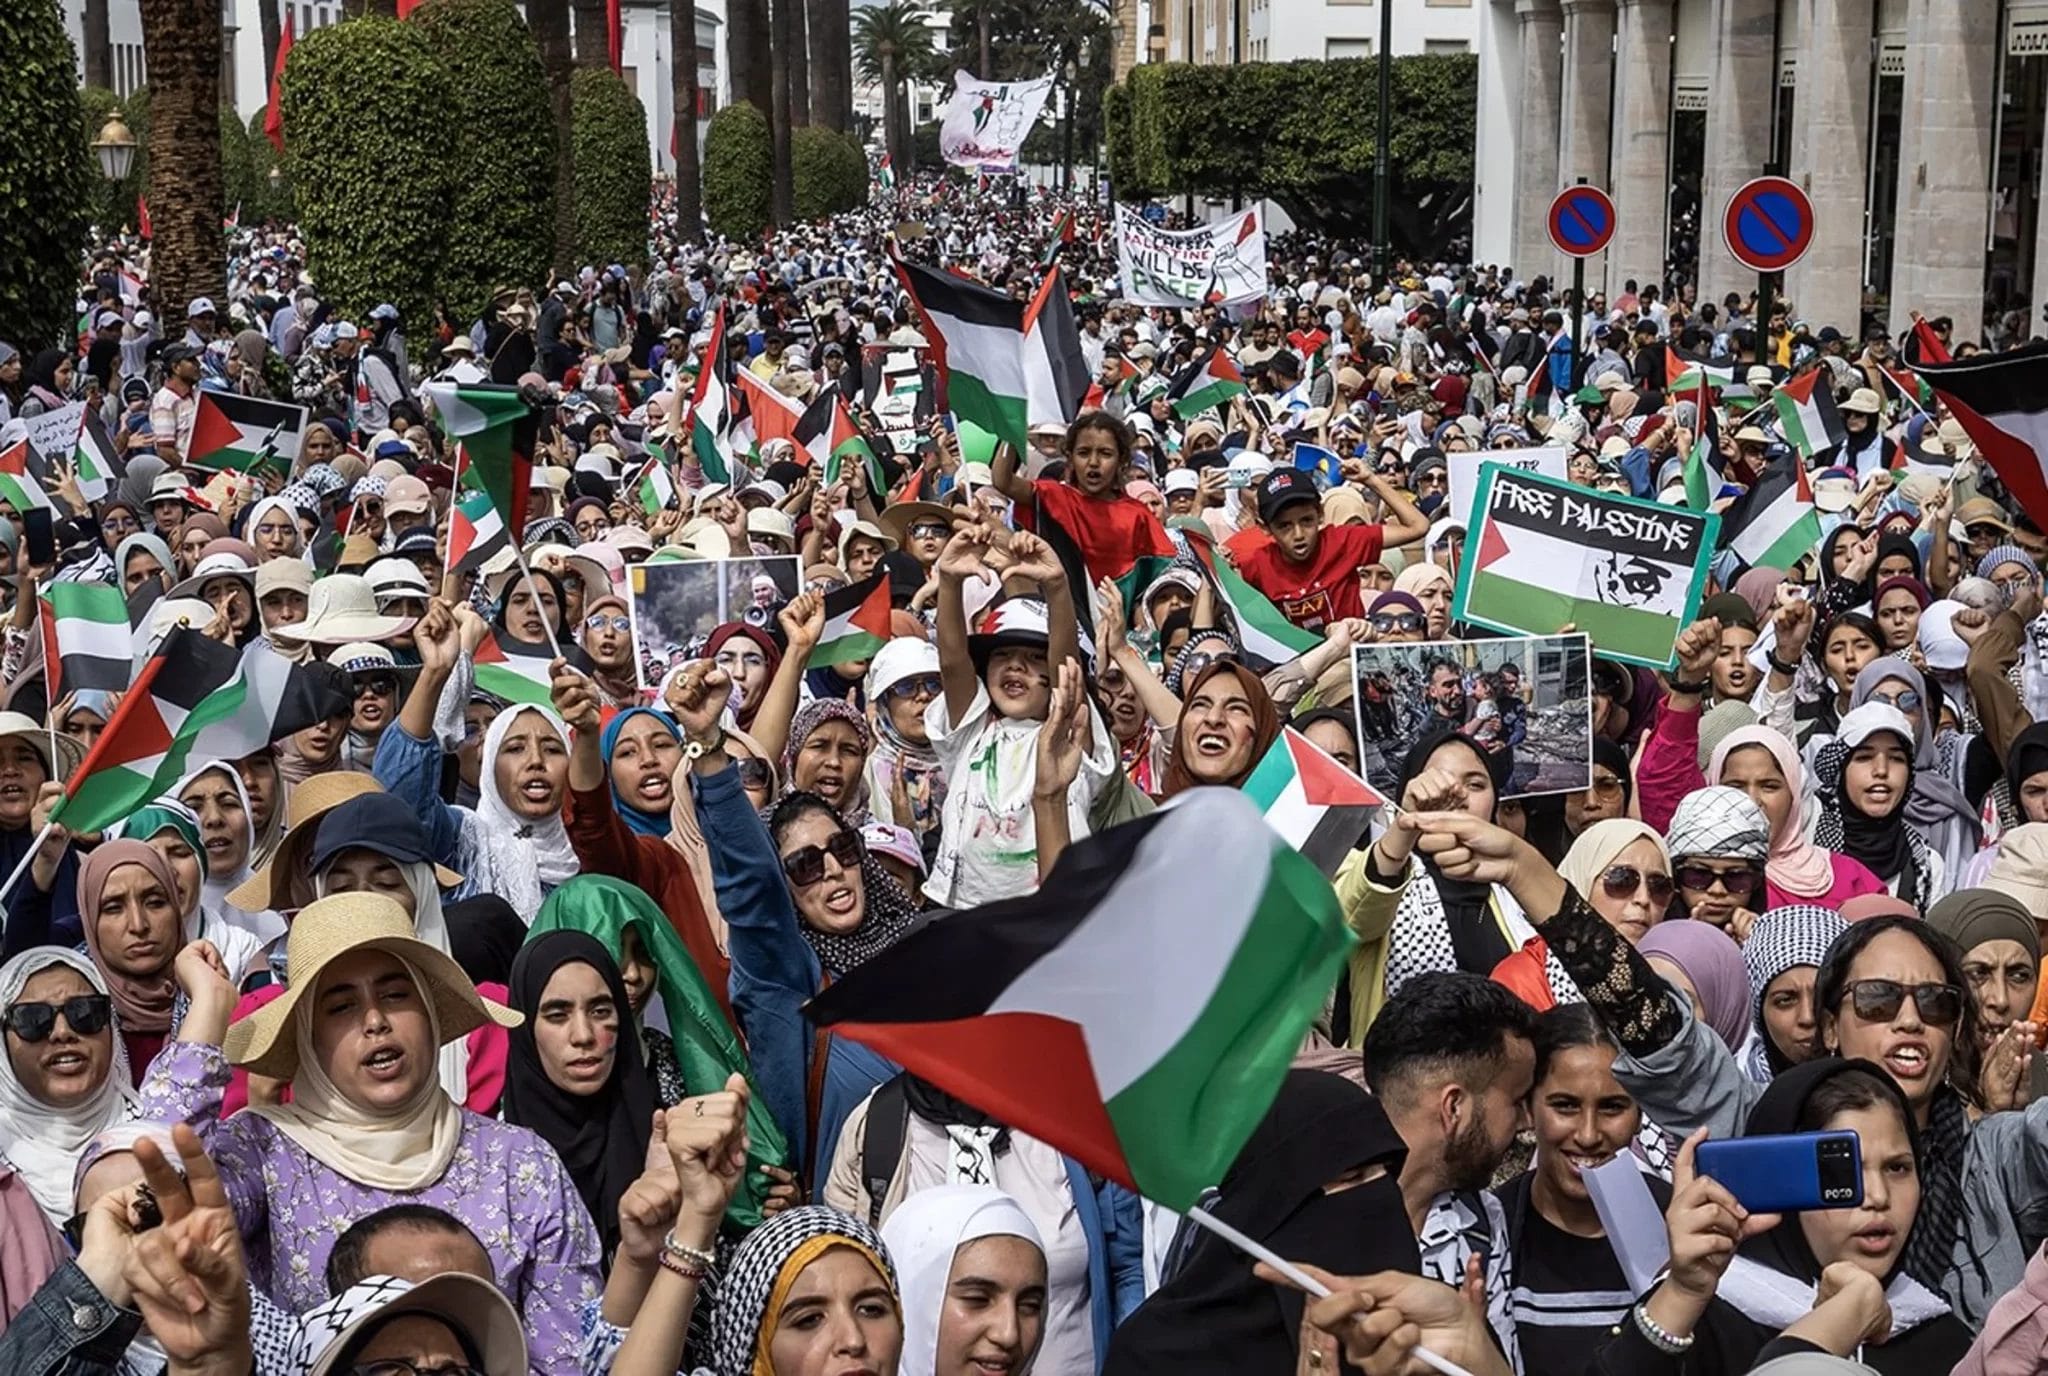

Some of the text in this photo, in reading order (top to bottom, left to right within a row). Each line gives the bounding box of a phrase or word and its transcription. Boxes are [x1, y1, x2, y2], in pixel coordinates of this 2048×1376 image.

[1126, 246, 1207, 281] WILL BE
[1131, 268, 1201, 301] FREE
[1492, 478, 1693, 551] FREE PALESTINE
[1824, 1188, 1853, 1199] POCO
